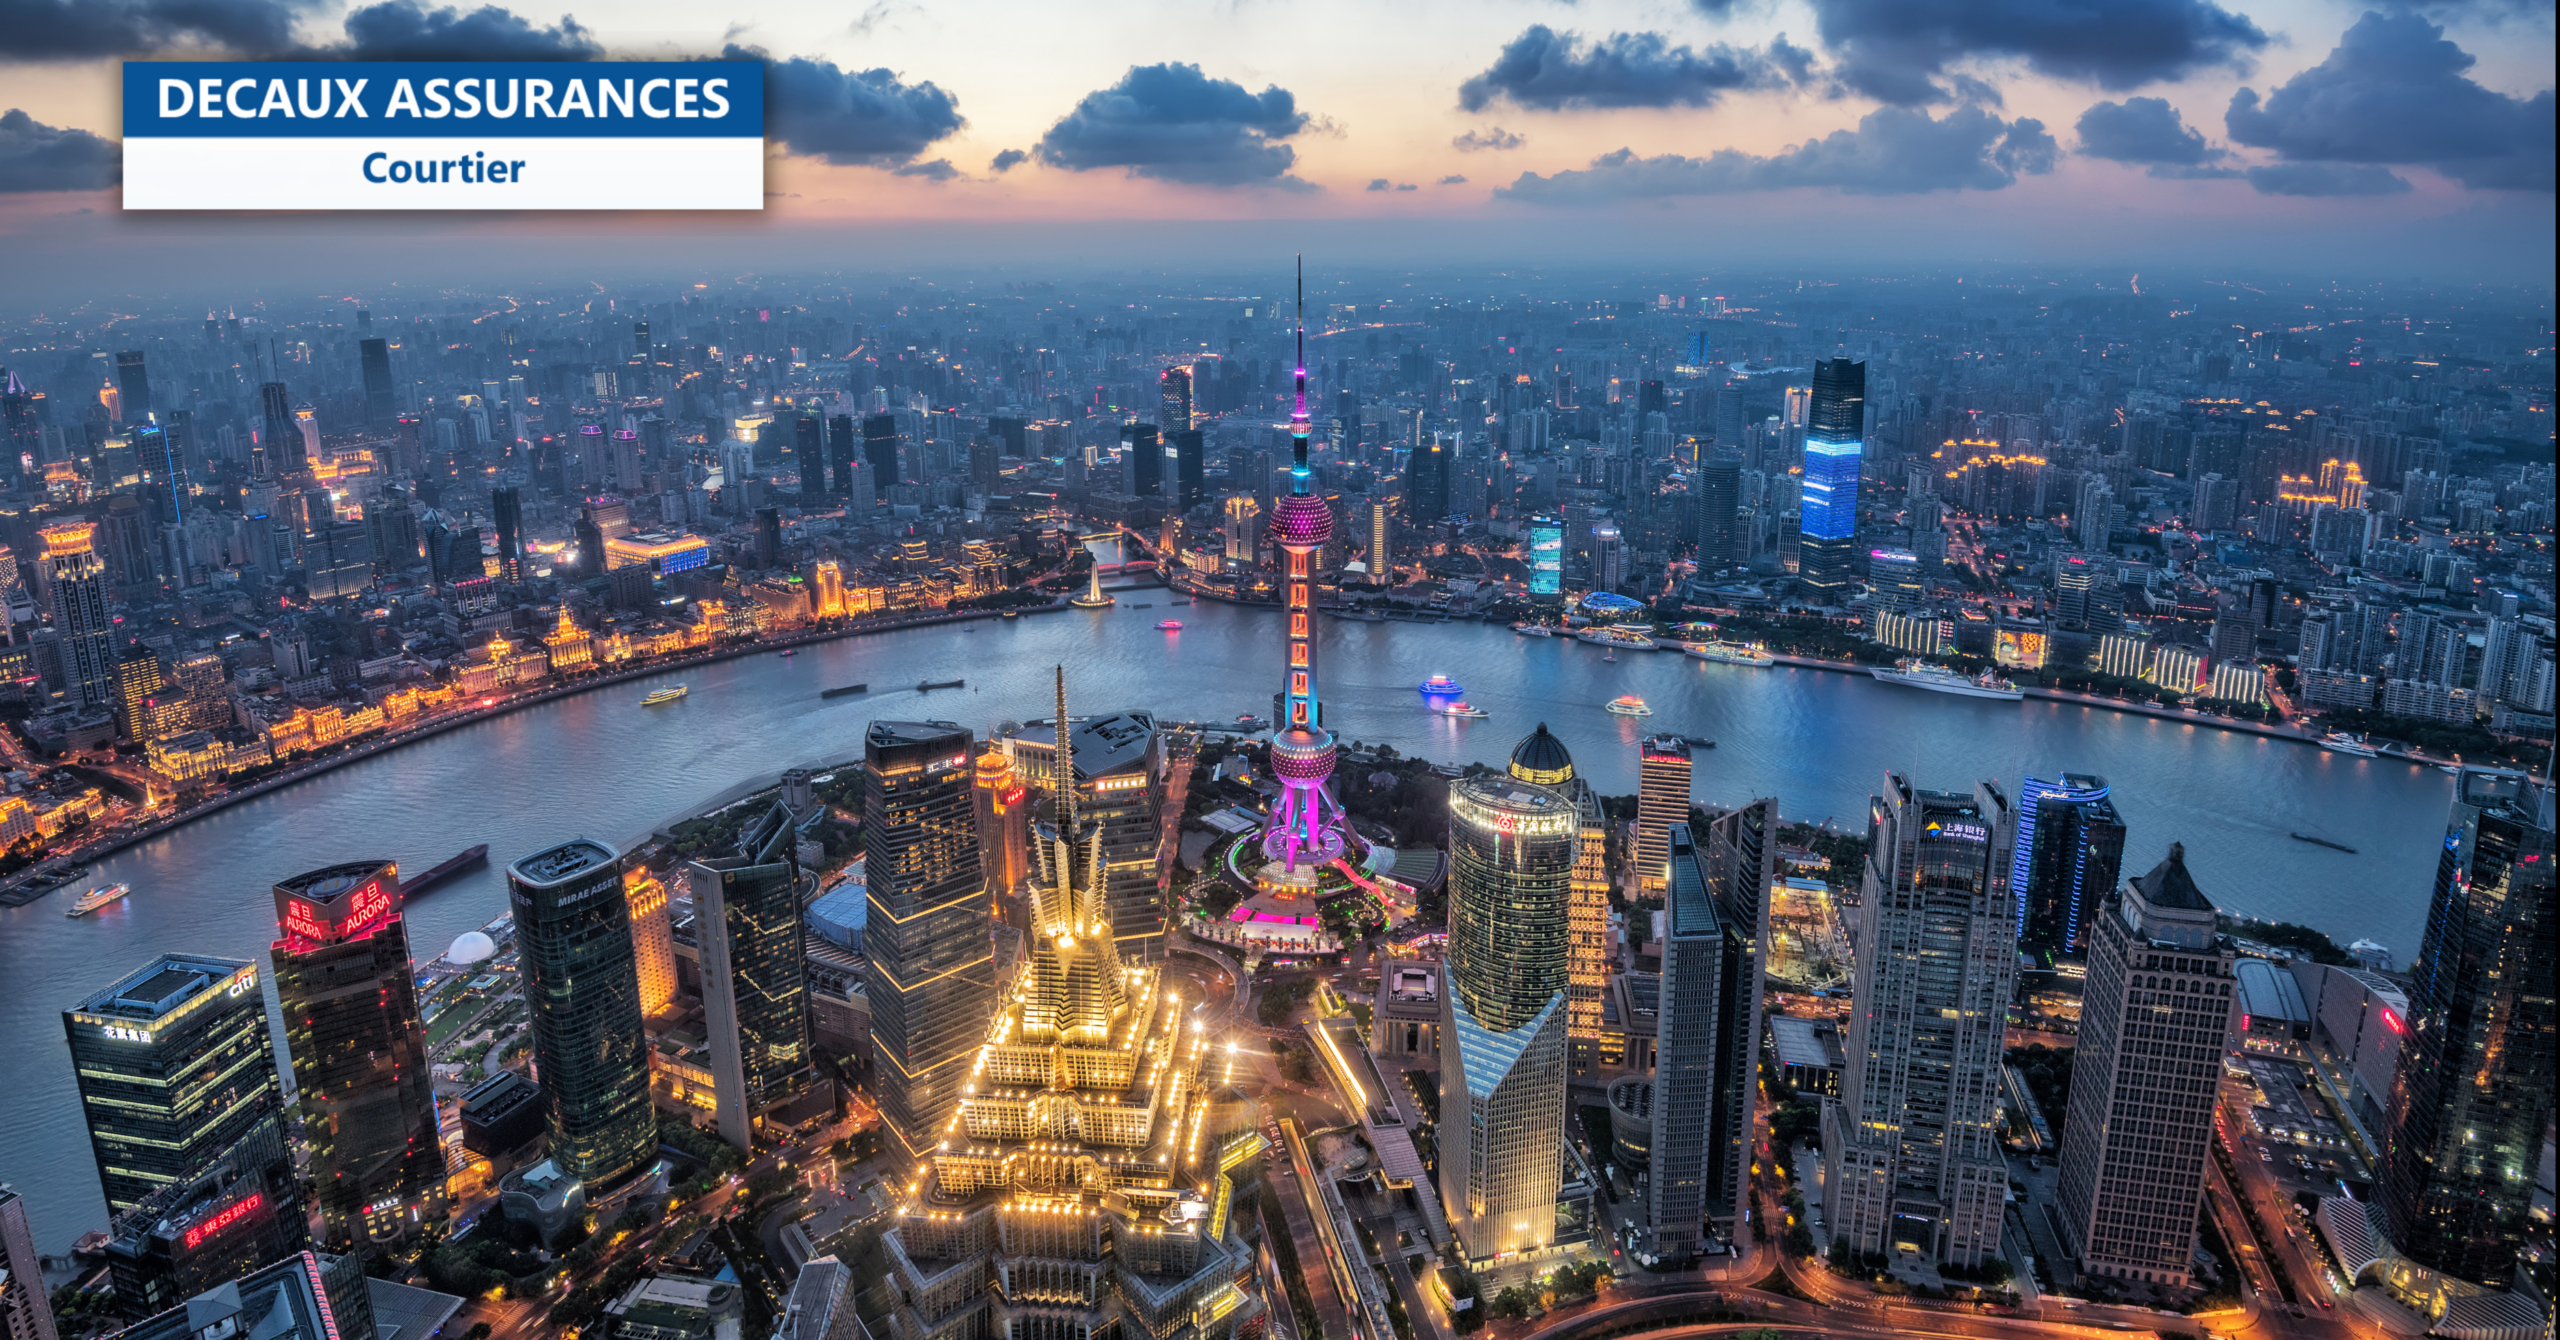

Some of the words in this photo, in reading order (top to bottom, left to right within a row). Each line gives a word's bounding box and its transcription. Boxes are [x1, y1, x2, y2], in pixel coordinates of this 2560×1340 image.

[1943, 823, 1986, 837] 上海银行
[558, 888, 590, 908] MIRAE
[591, 876, 618, 896] ASSET
[346, 894, 390, 934] AURORA
[286, 915, 323, 940] AURORA
[229, 974, 254, 998] citi
